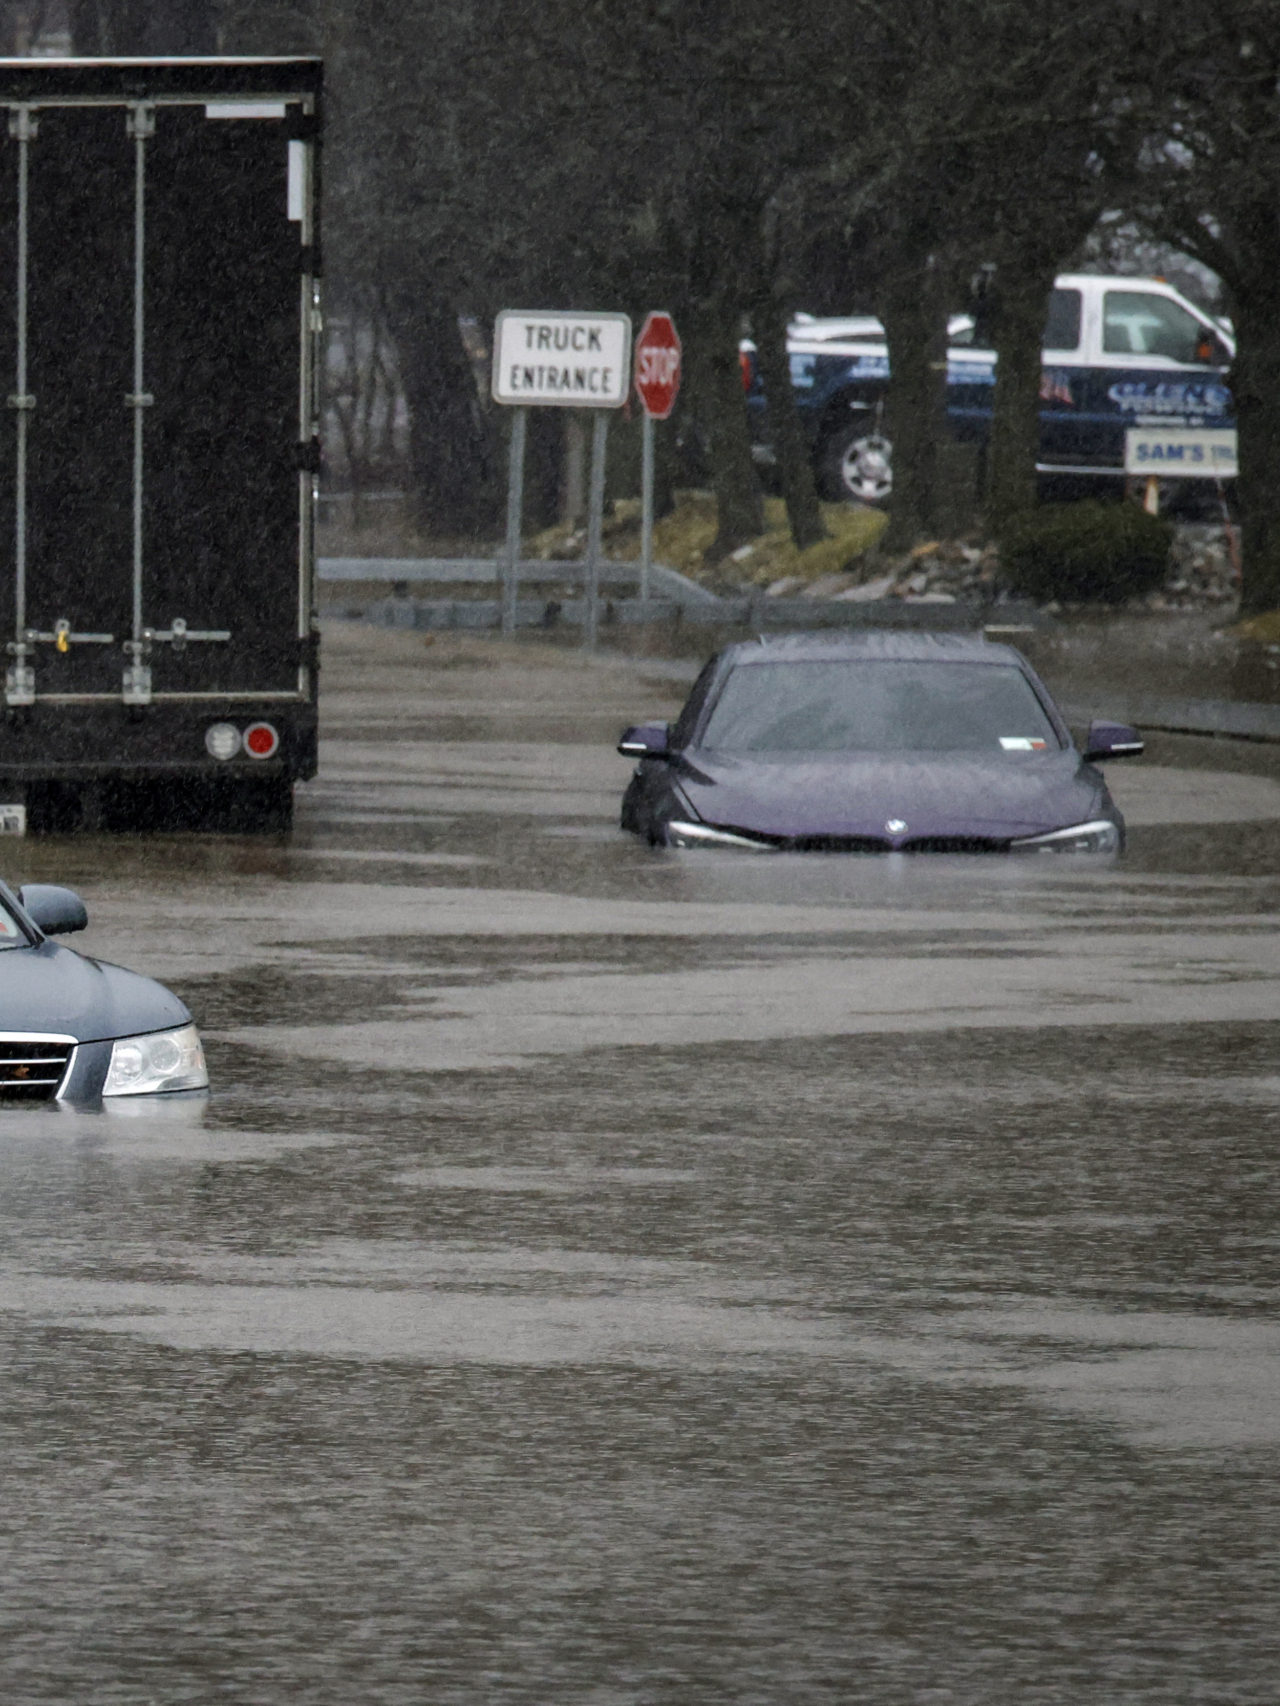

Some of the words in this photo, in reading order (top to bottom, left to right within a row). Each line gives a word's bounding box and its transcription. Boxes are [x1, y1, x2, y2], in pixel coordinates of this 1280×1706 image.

[524, 324, 602, 351] TRUCK
[510, 364, 612, 393] ENTRANCE
[639, 347, 679, 384] STOP
[1136, 443, 1204, 462] SAM'S
